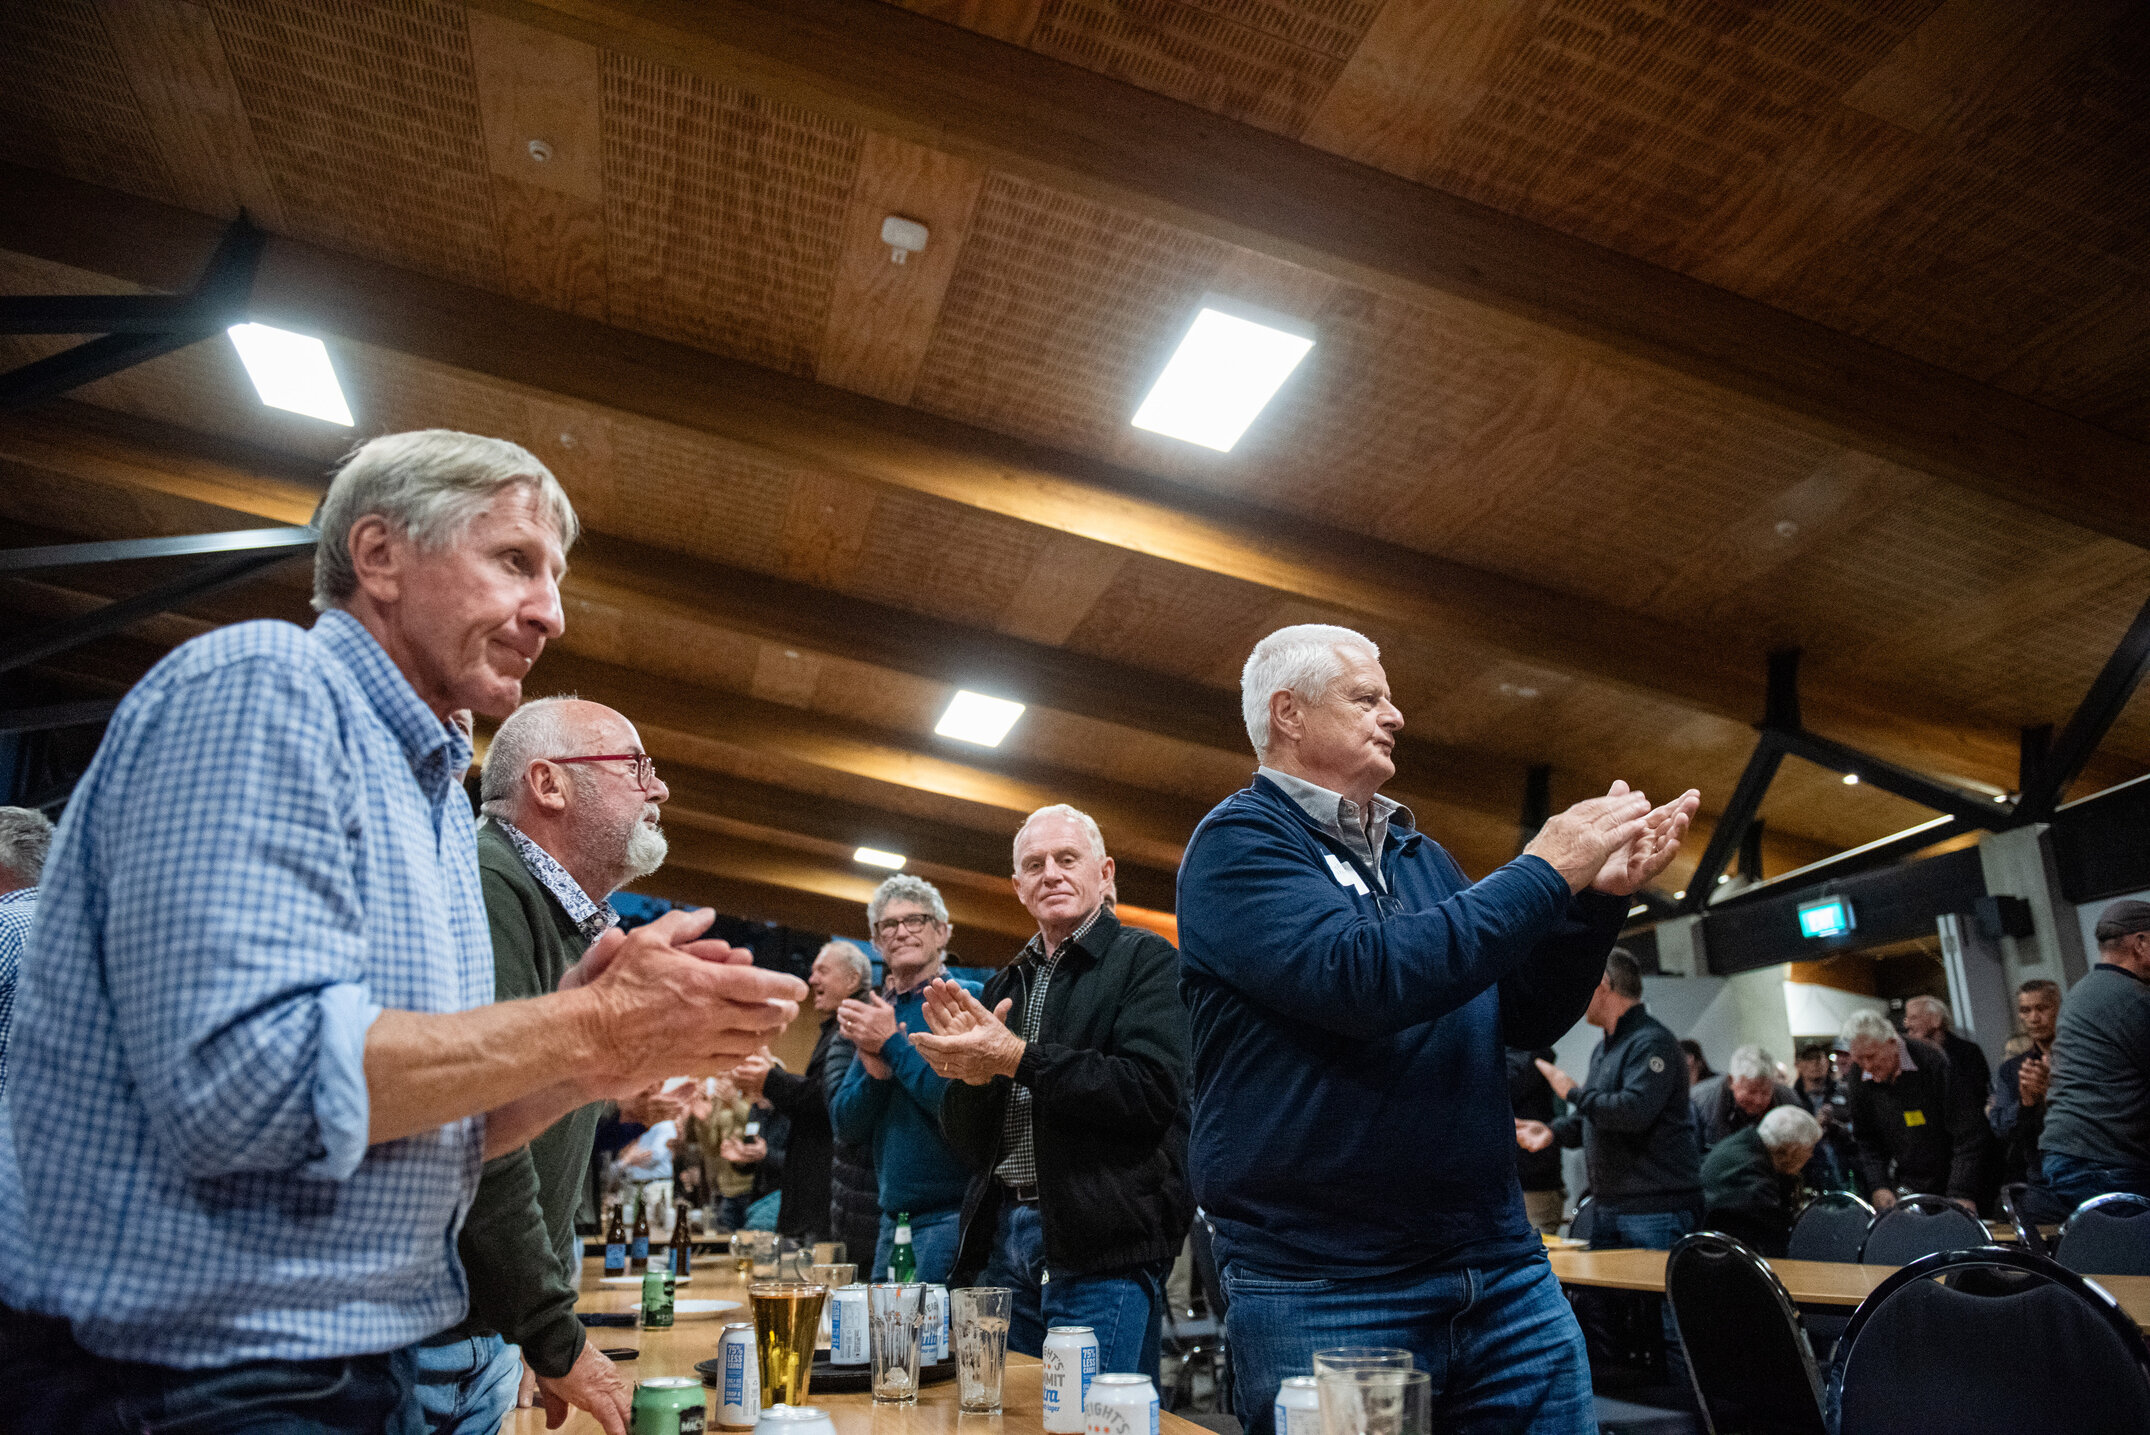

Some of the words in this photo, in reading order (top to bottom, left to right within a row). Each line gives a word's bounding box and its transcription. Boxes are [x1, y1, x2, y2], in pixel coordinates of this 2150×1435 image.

[1082, 1348, 1096, 1359] 75%
[727, 1354, 743, 1363] LESS
[1082, 1358, 1096, 1367] LESS
